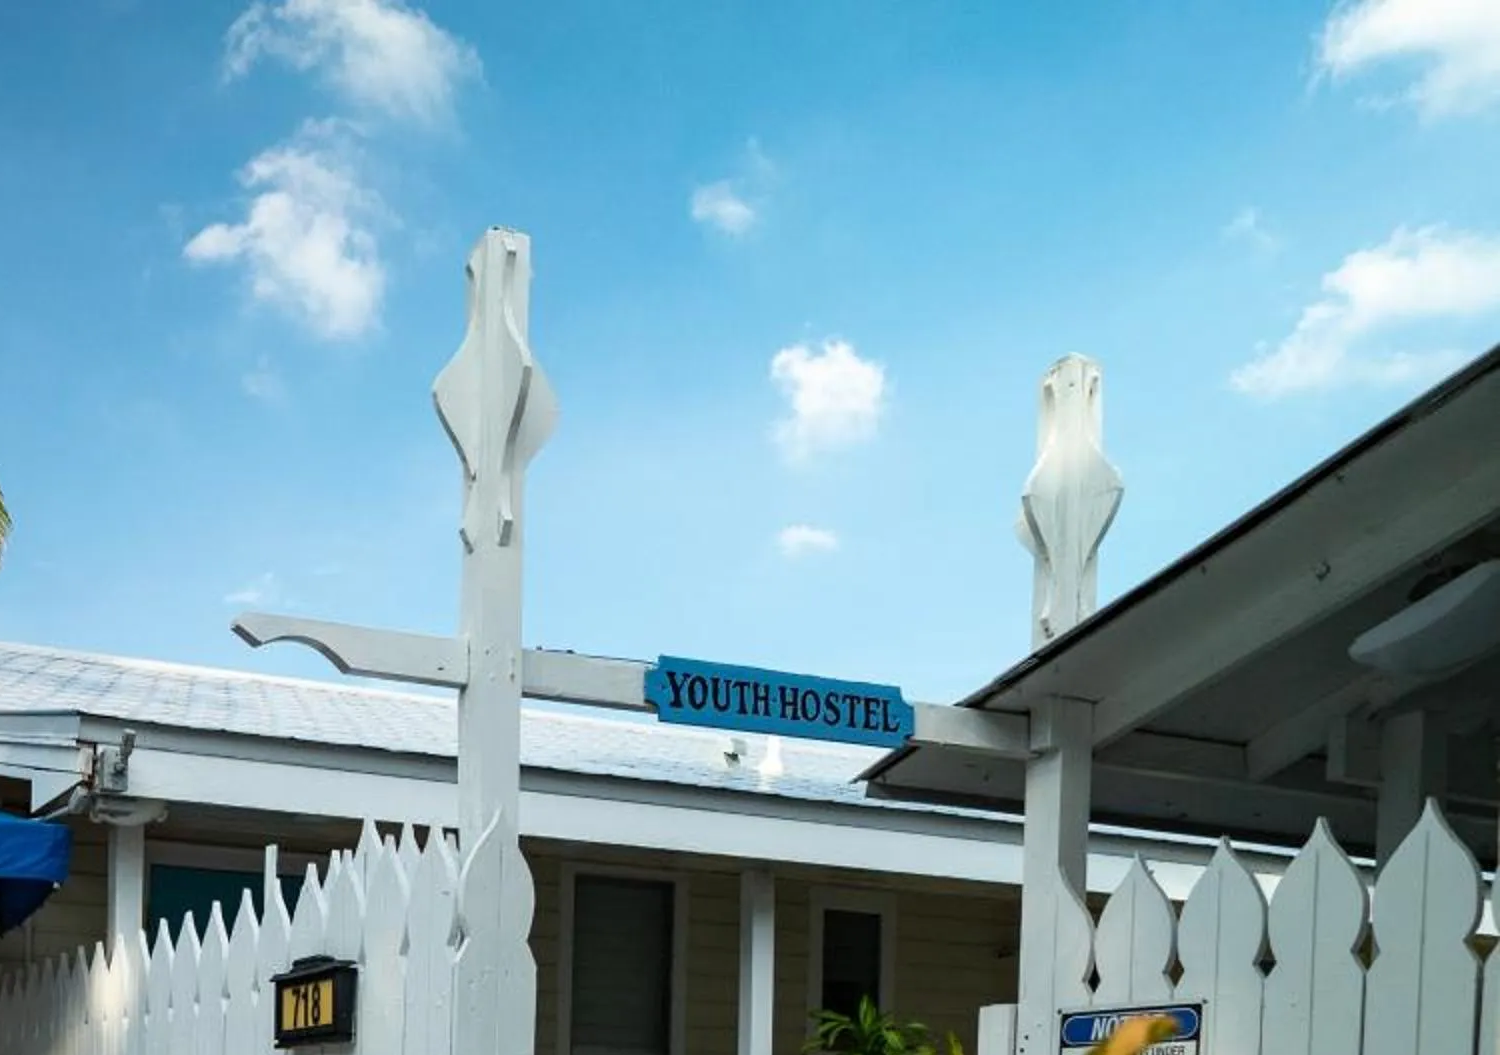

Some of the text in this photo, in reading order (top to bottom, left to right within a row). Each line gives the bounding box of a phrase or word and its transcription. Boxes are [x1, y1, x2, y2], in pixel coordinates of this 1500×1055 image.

[666, 672, 900, 734] YOUTH HOSTEL
[291, 983, 321, 1028] 718
